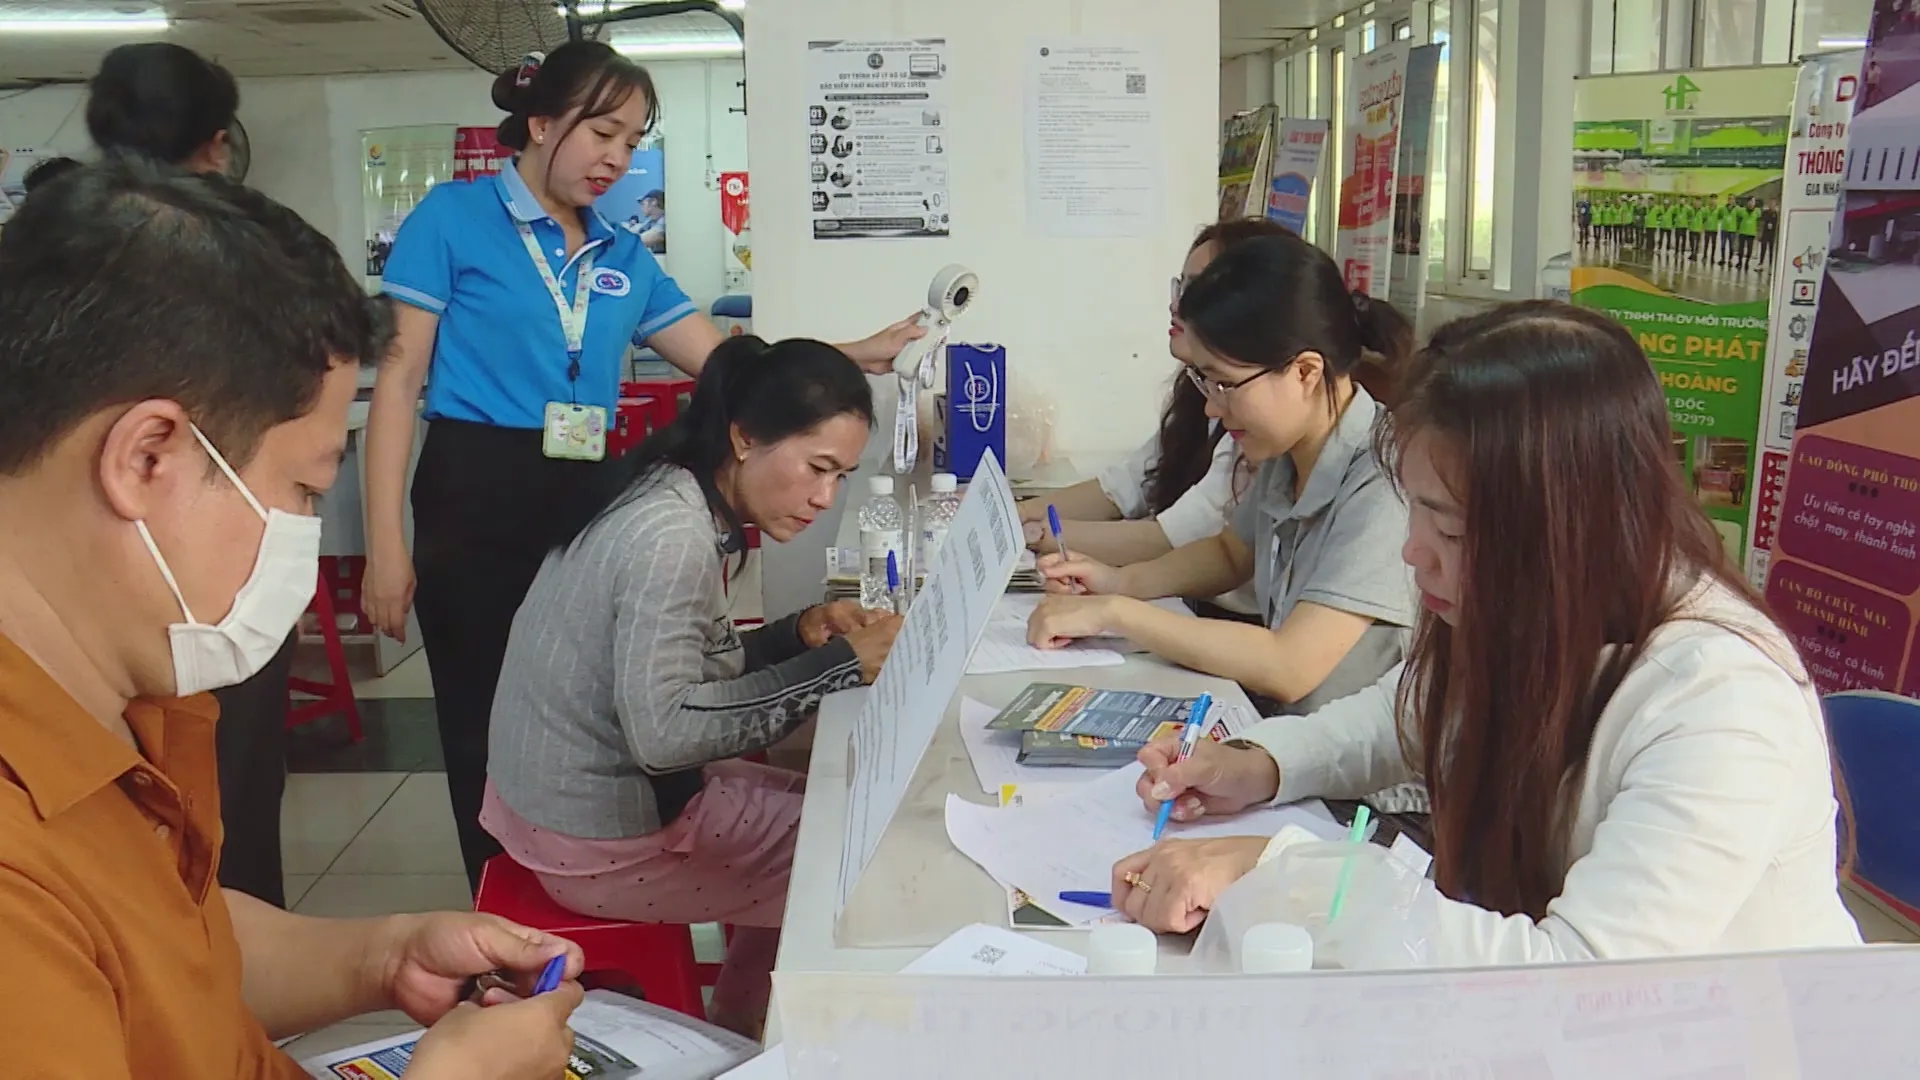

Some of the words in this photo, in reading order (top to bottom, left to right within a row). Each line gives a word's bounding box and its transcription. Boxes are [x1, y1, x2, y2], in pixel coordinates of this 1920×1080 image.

[1808, 122, 1833, 140] Công
[1835, 122, 1846, 138] ty
[1798, 146, 1845, 175] THÔNG
[1623, 311, 1656, 321] TNHH
[1694, 314, 1719, 326] MÔI
[1684, 332, 1762, 362] PHÁT
[1832, 354, 1880, 395] HÃY
[1892, 474, 1920, 493] THÔ
[1803, 493, 1821, 509] Ưu
[1823, 500, 1845, 516] tiên
[1847, 508, 1861, 521] có
[1863, 512, 1884, 531] tay
[1860, 659, 1886, 681] kinh
